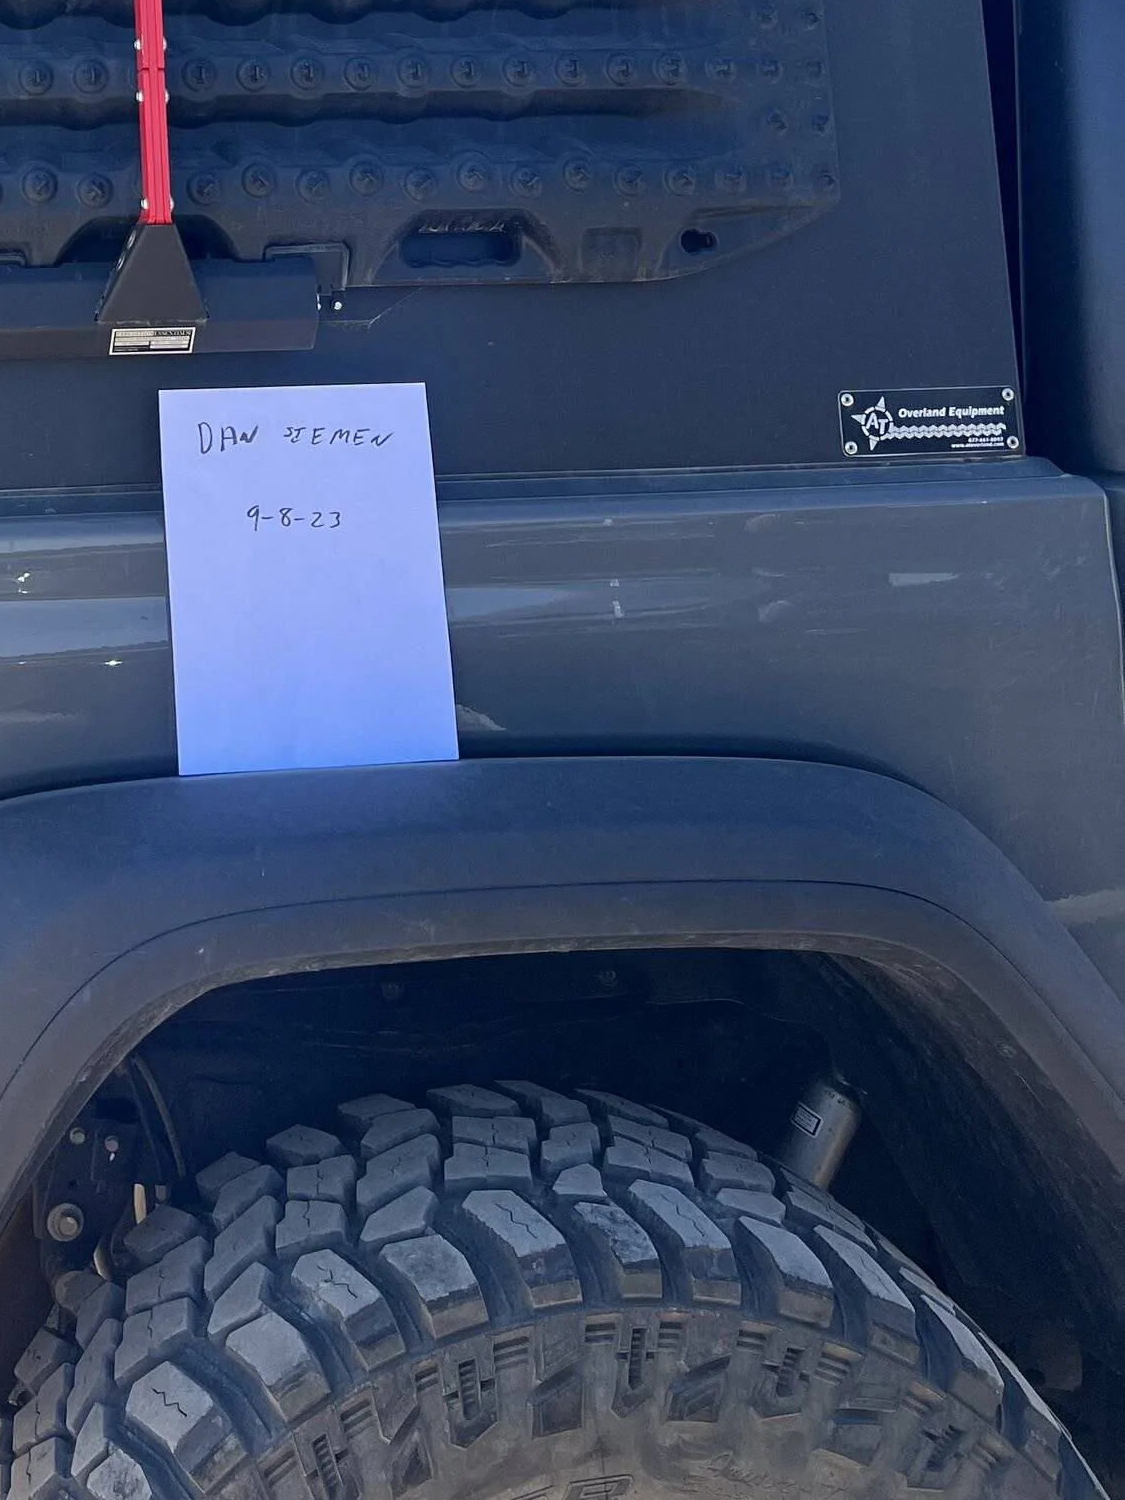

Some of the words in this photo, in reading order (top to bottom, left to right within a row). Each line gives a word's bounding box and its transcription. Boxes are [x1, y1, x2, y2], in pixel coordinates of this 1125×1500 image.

[898, 406, 946, 419] Overland
[948, 405, 1005, 419] Equipment
[198, 422, 258, 455] DAN
[246, 504, 342, 532] 9-8-23
